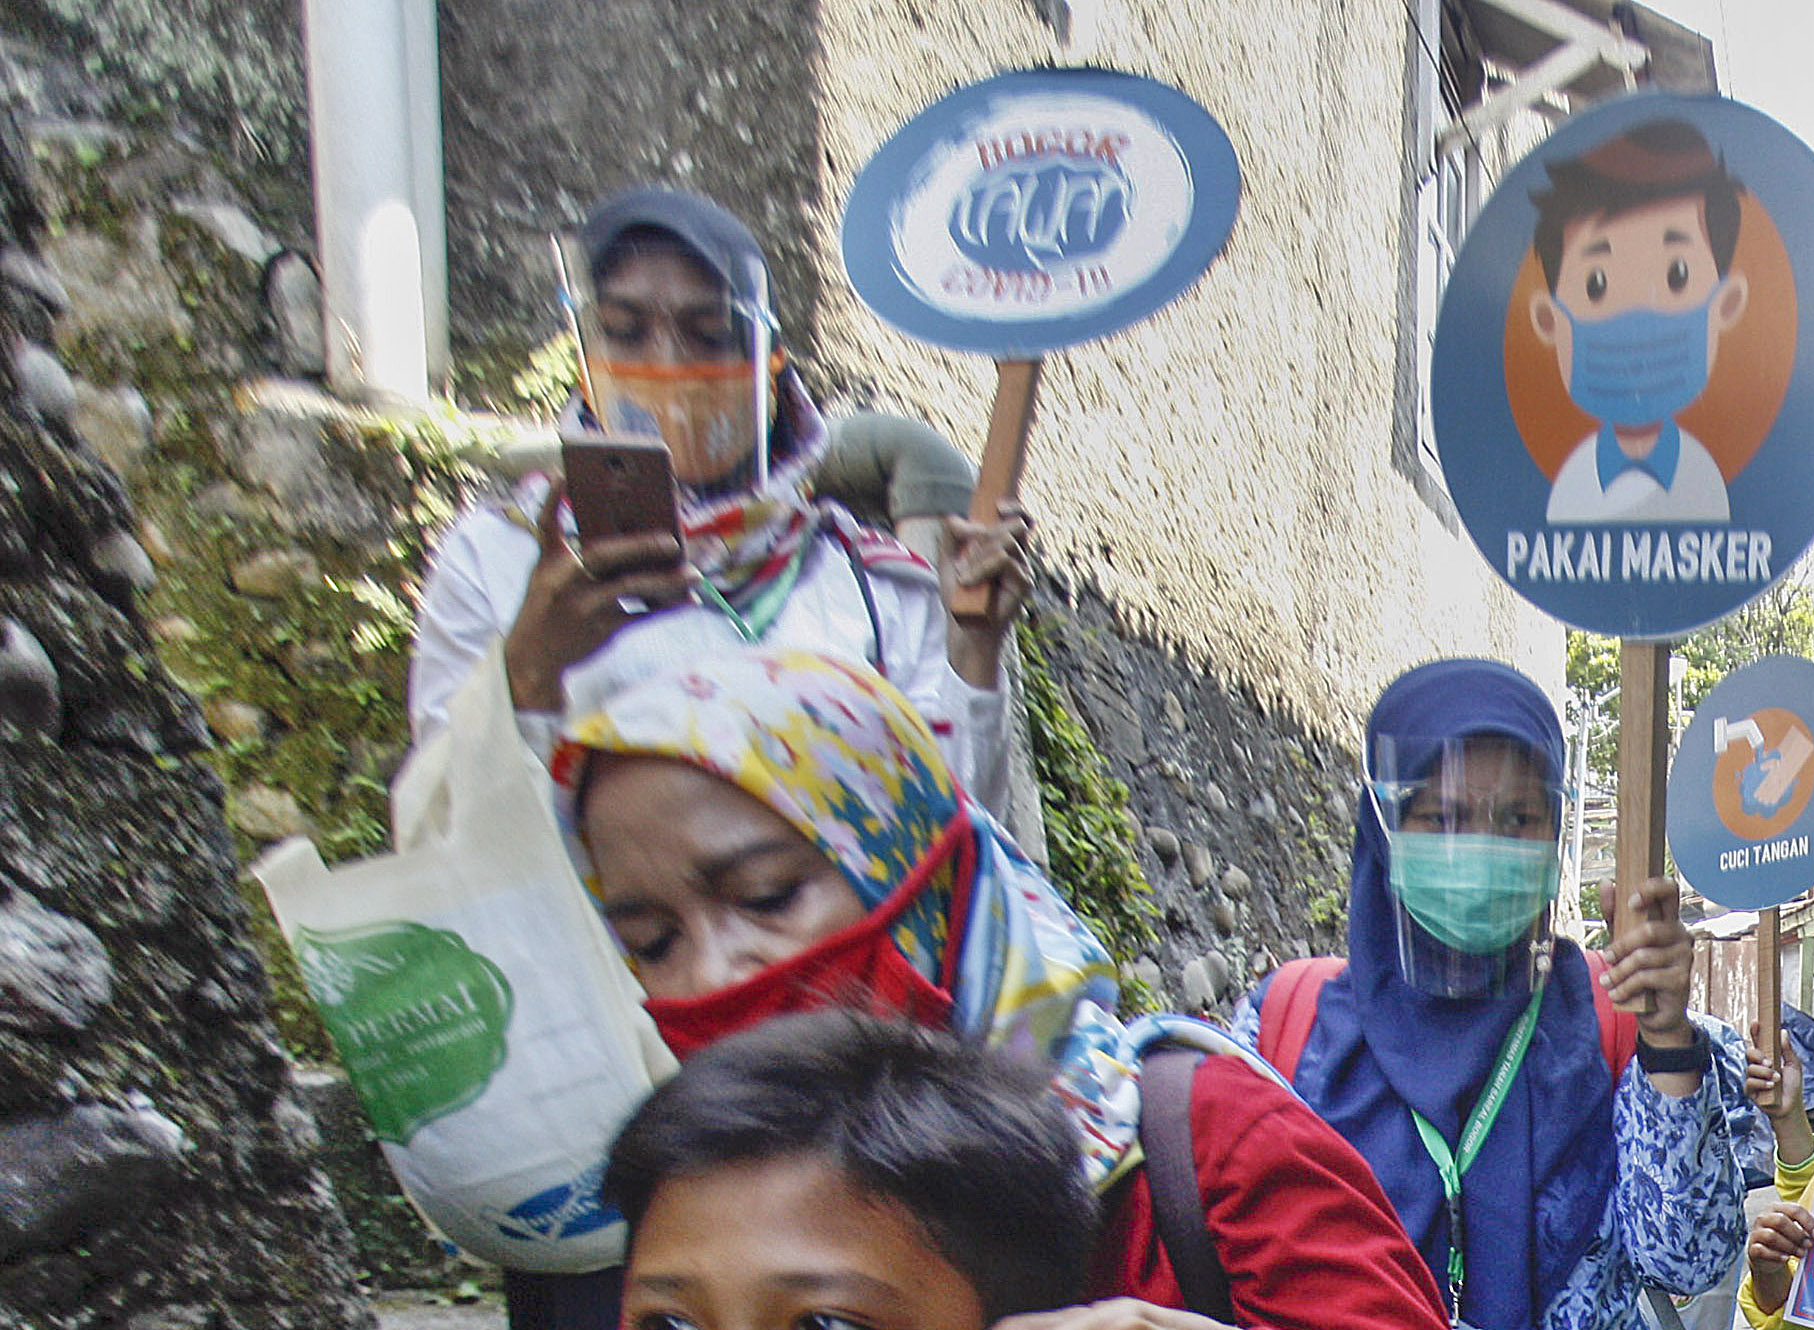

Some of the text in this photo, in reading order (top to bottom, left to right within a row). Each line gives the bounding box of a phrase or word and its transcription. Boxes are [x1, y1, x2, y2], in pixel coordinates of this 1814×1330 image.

[1507, 530, 1772, 583] PAKAI MASKER
[1720, 835, 1809, 871] CUCI TANGAN
